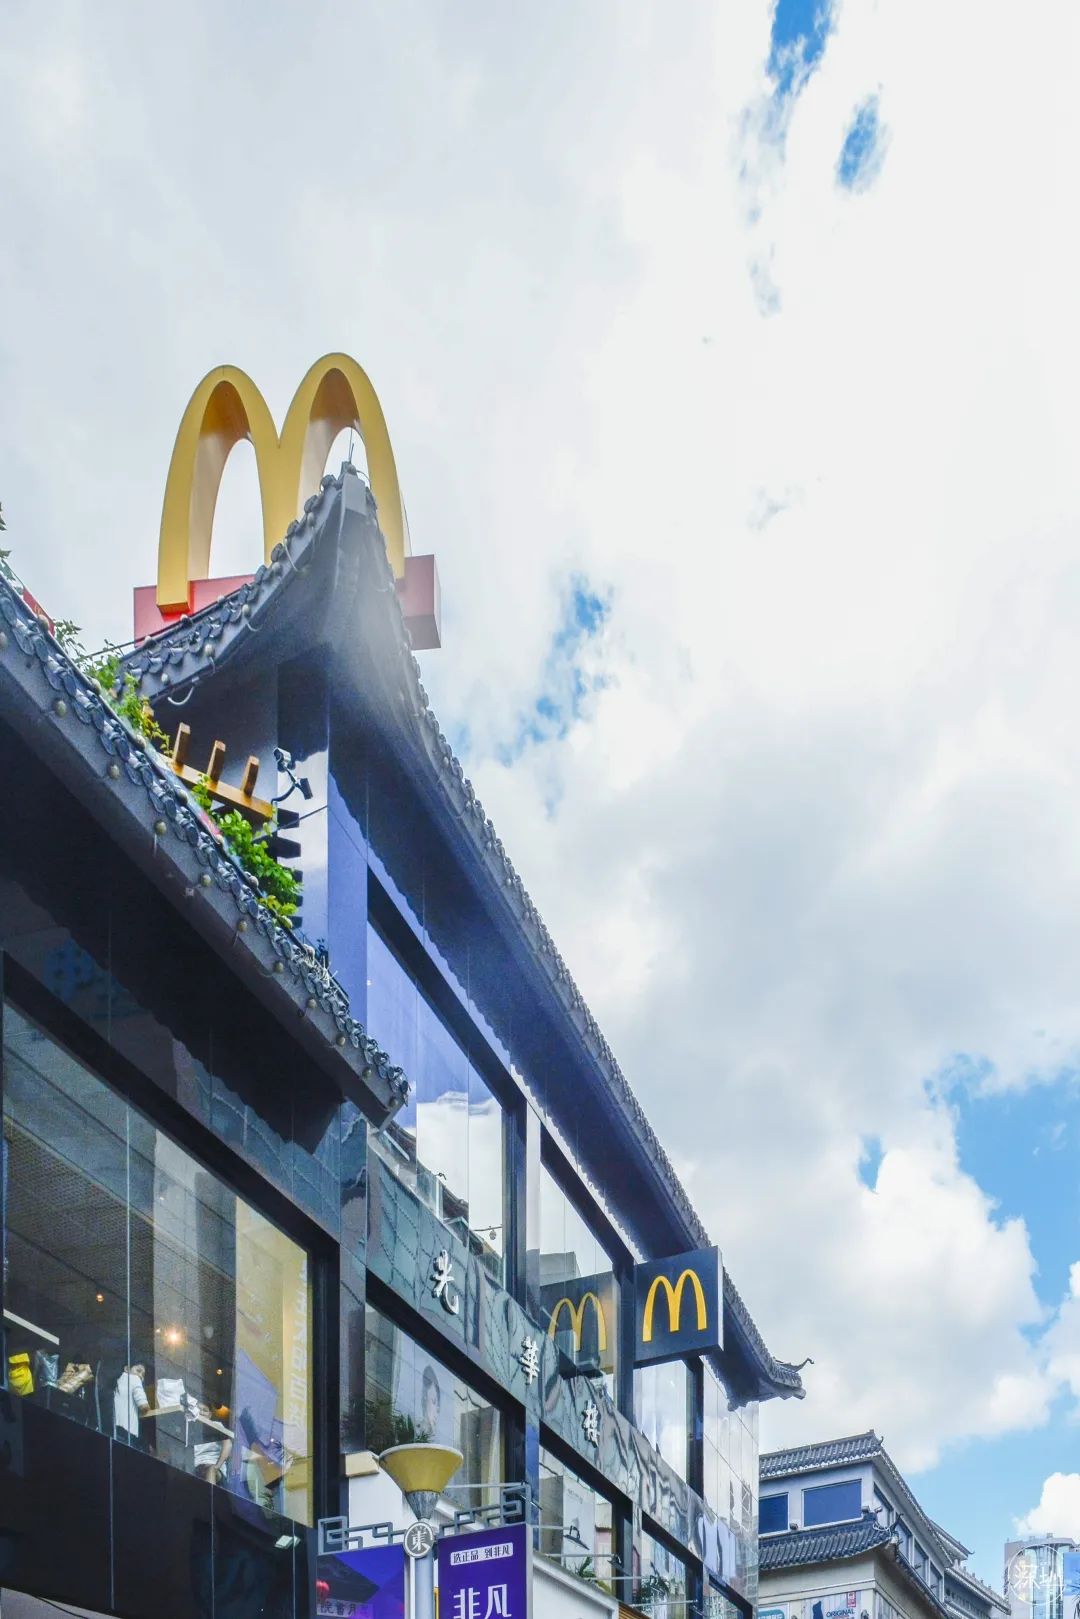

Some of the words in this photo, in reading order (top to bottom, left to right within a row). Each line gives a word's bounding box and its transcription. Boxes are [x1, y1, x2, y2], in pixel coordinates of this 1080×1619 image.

[453, 1549, 479, 1564] 选正品
[484, 1544, 511, 1559] 到非凡
[826, 1608, 855, 1618] ORIGINAL
